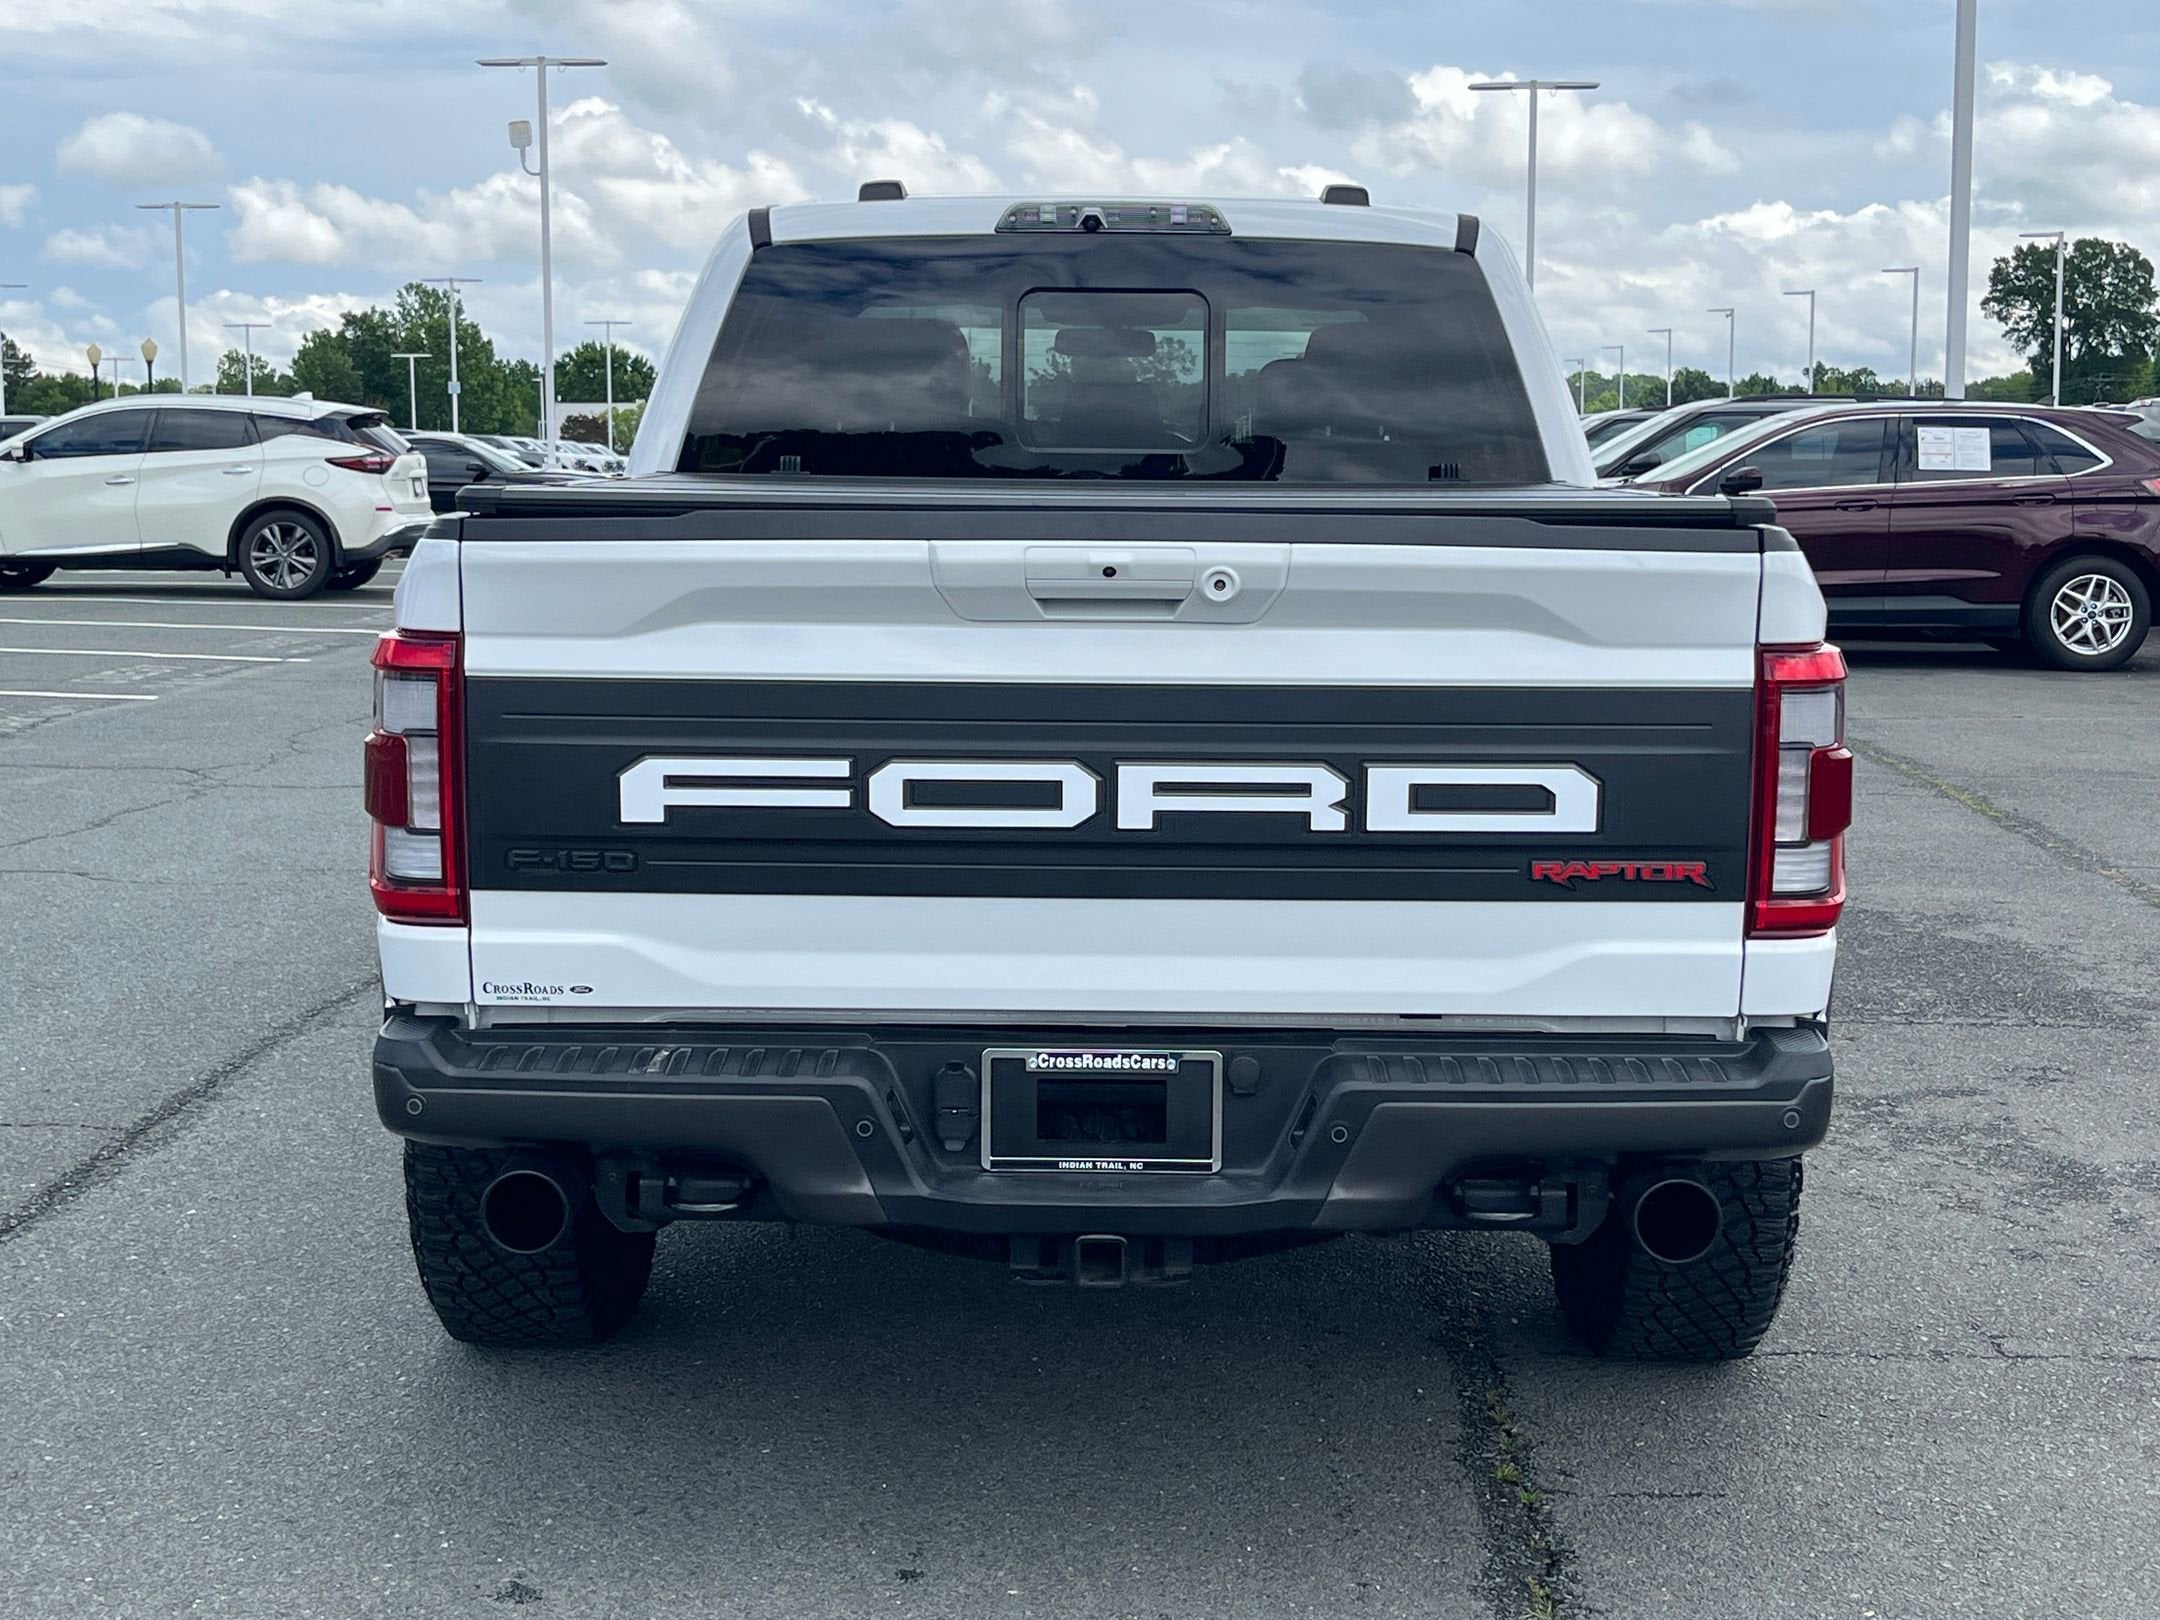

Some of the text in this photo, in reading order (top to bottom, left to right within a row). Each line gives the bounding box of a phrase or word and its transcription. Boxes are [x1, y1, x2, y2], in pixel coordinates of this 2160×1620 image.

[618, 757, 1600, 834] FORD
[508, 849, 636, 872] F-150
[1531, 860, 1715, 890] RAPTOR
[1037, 1053, 1167, 1071] CrossRoadsCars
[1058, 1161, 1093, 1169] INDIAN
